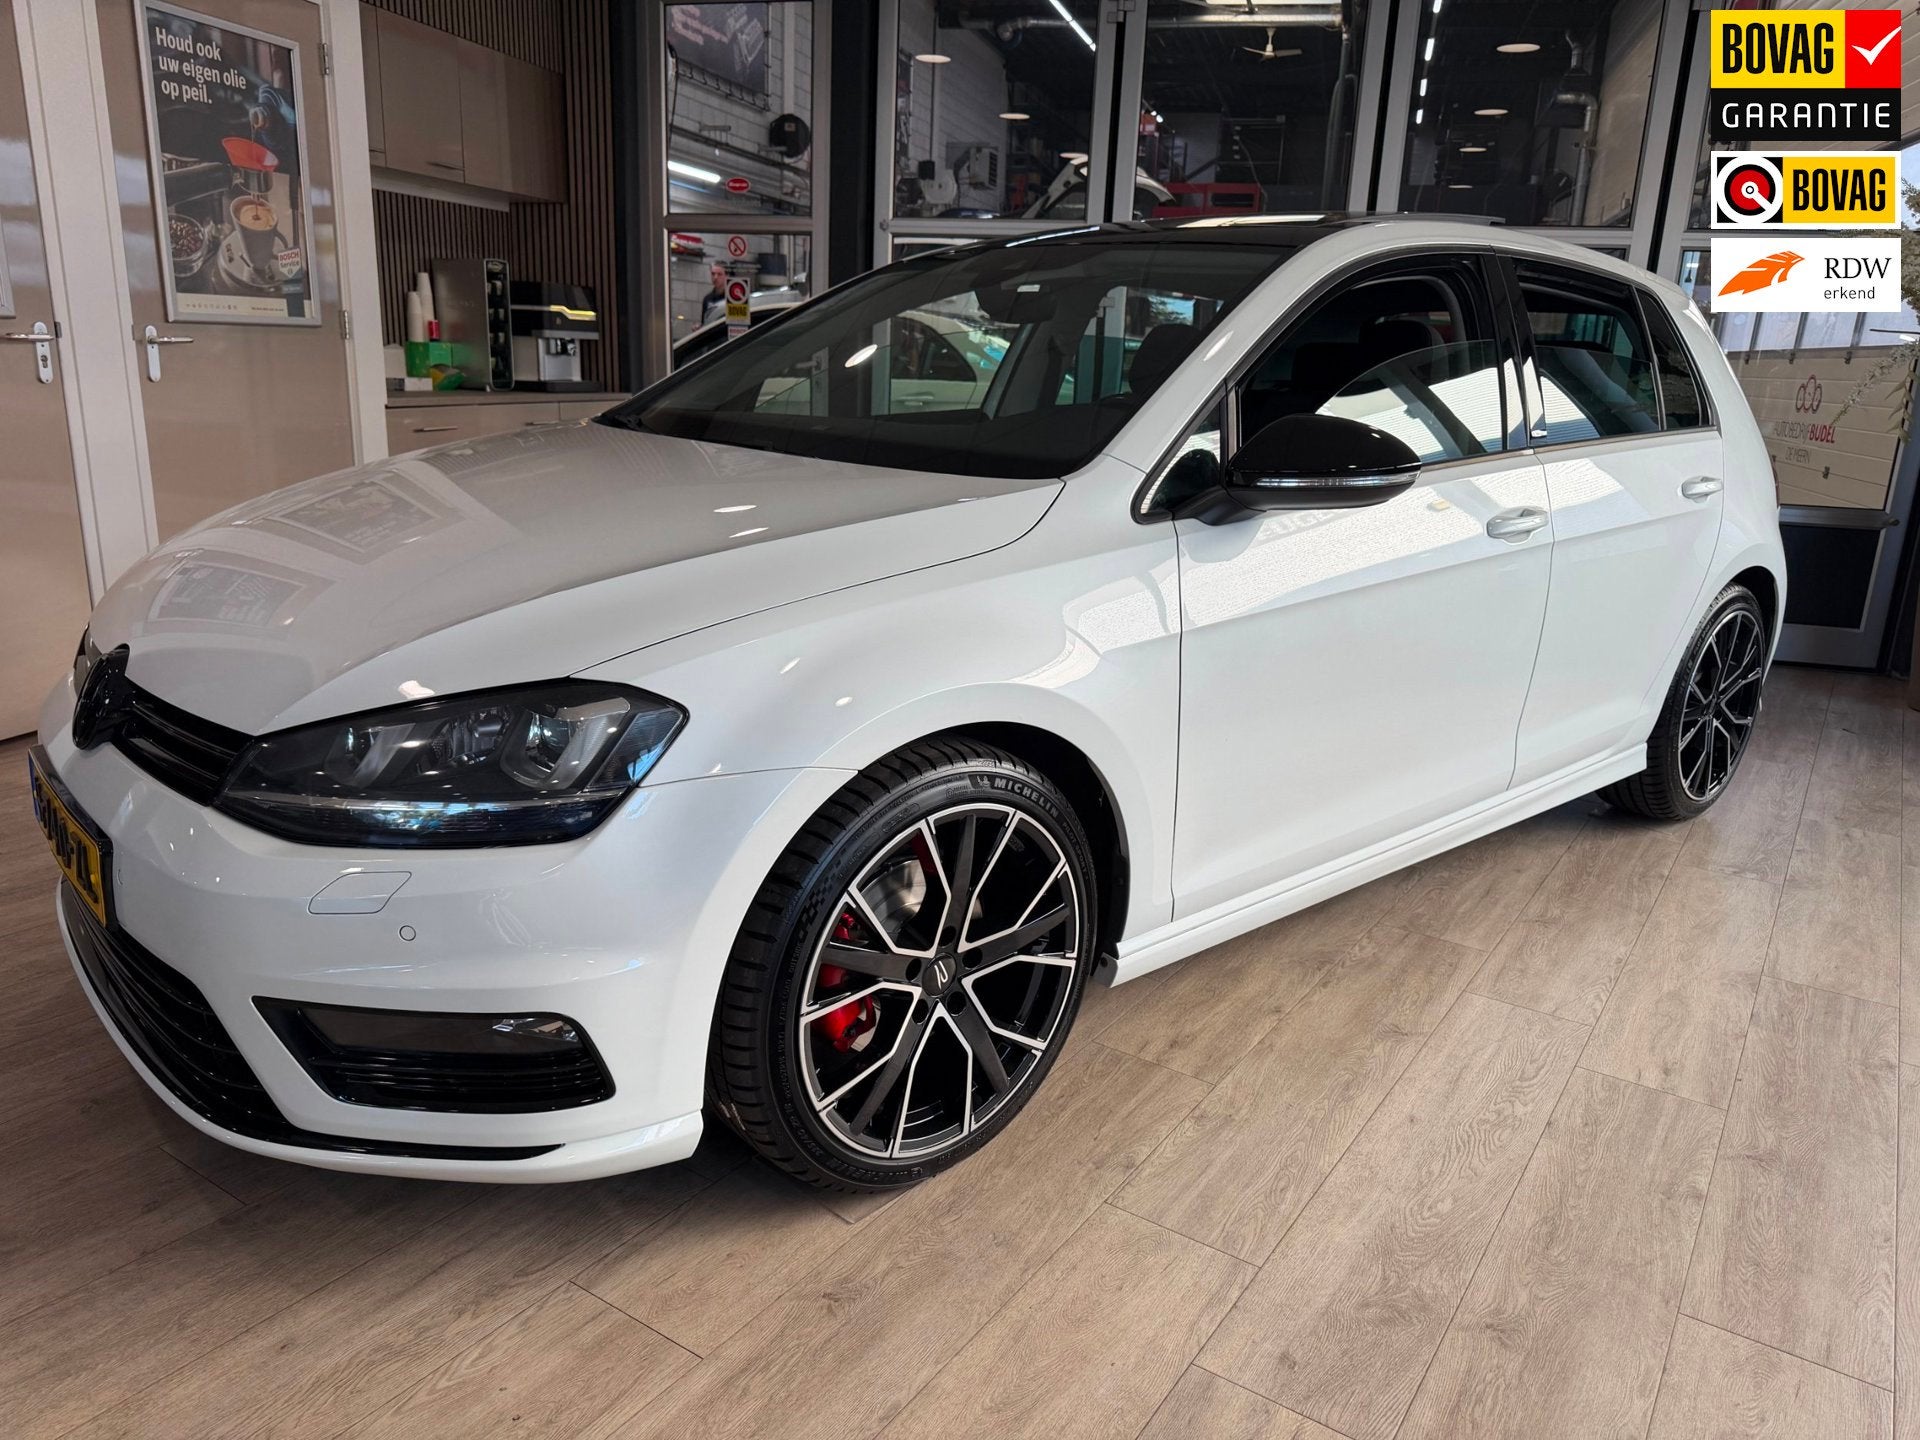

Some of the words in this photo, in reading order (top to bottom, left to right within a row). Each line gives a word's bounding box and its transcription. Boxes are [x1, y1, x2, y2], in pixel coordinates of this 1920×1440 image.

[155, 26, 193, 54] Houd
[196, 41, 222, 61] ook
[158, 55, 179, 73] uw
[182, 59, 220, 84] eigen
[223, 68, 247, 90] olie
[161, 80, 179, 100] op
[182, 83, 213, 104] peil.
[1809, 424, 1835, 443] BUDEL
[994, 777, 1059, 818] MICHELIN
